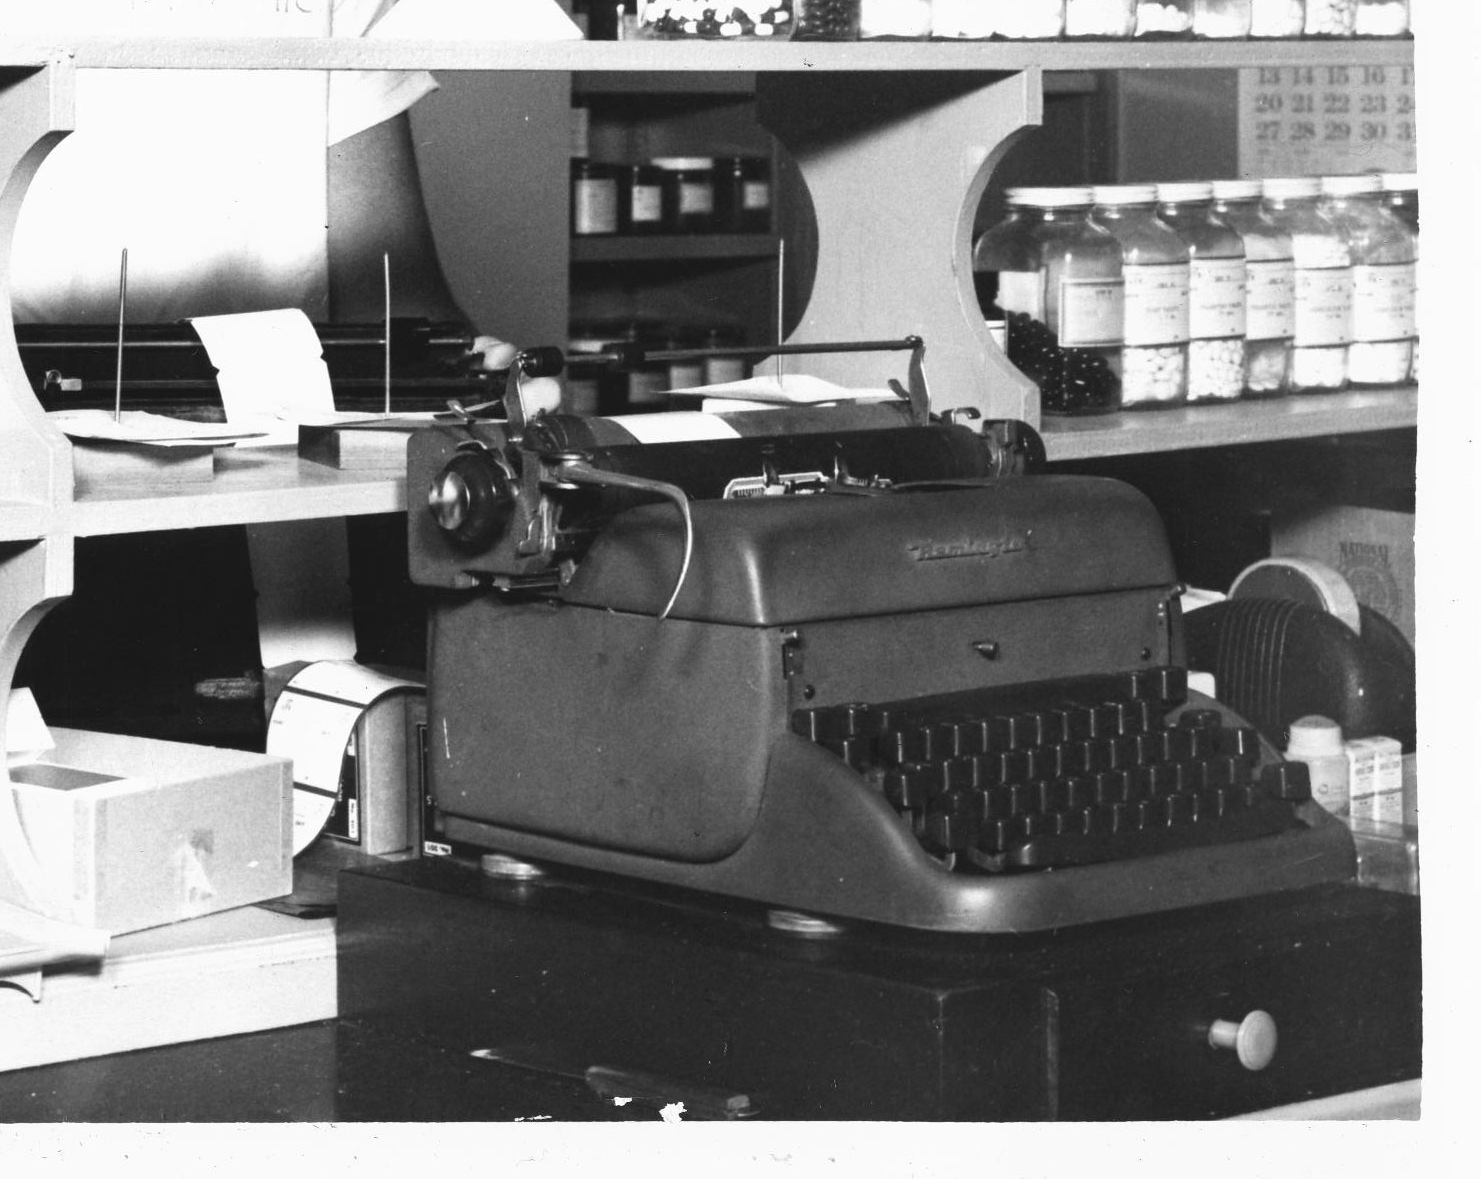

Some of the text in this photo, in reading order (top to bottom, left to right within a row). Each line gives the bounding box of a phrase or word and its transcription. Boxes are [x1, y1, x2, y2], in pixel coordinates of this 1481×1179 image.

[1324, 94, 1350, 113] 22
[1360, 94, 1387, 113] 23
[1255, 121, 1281, 140] 27
[1360, 122, 1387, 141] 30
